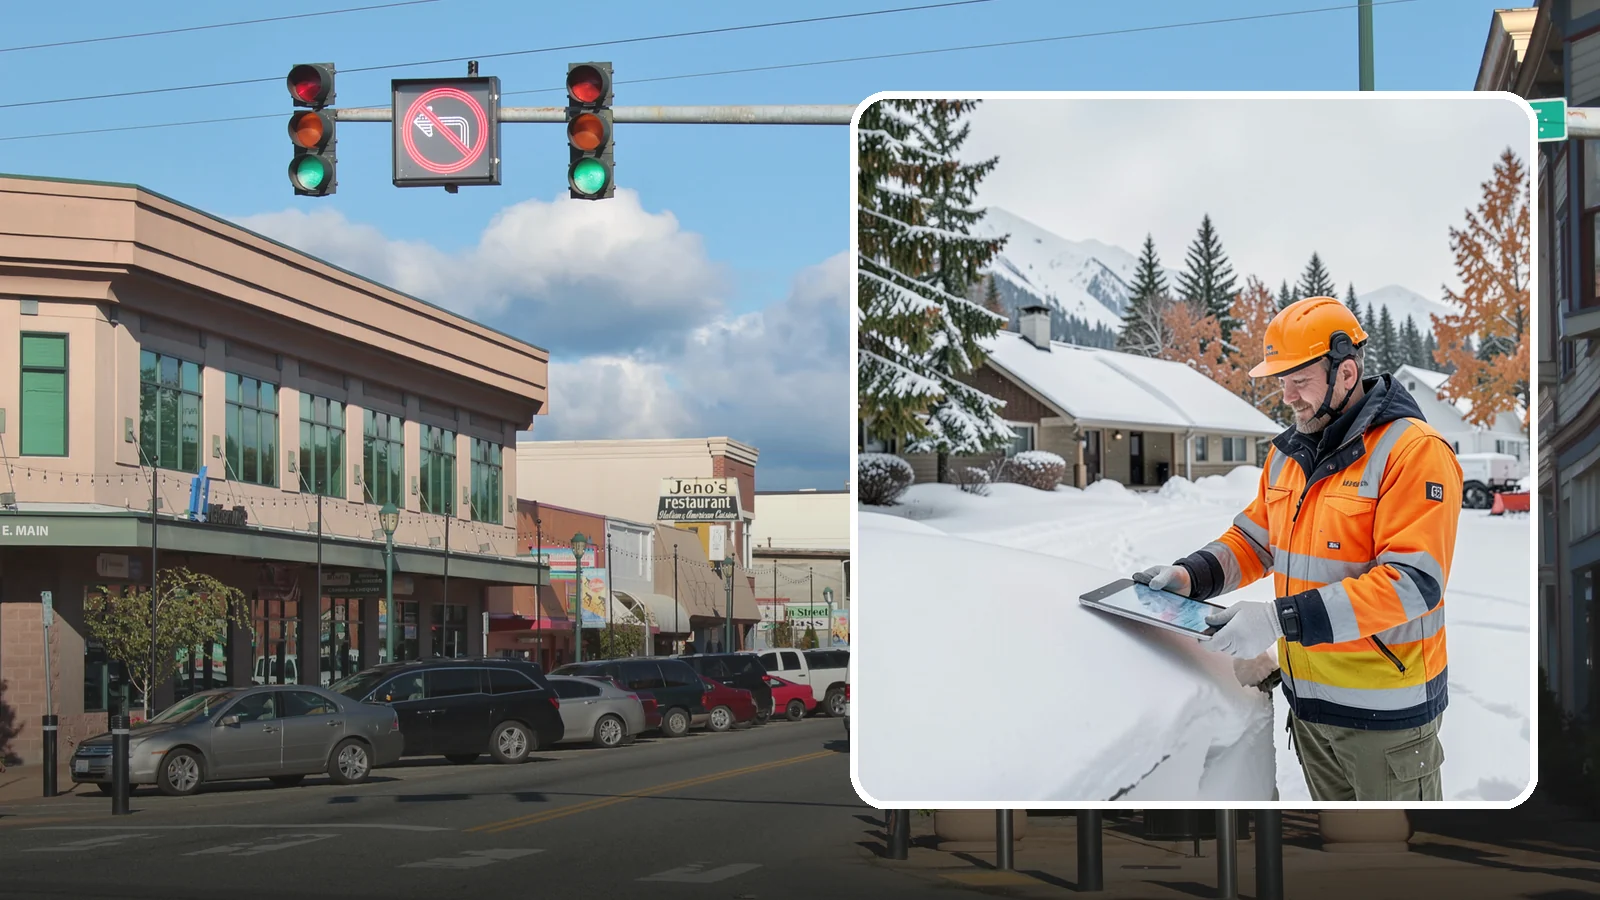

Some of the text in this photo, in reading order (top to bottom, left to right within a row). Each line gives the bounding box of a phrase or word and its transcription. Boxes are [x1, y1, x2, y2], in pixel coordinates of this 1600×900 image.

[670, 480, 727, 494] Jeno's
[665, 497, 731, 509] restaurant
[659, 510, 681, 519] Italian
[686, 510, 714, 519] American
[715, 509, 737, 519] Cuisine
[2, 525, 49, 536] E. MAIN
[797, 607, 828, 616] Street
[790, 619, 823, 627] lass
